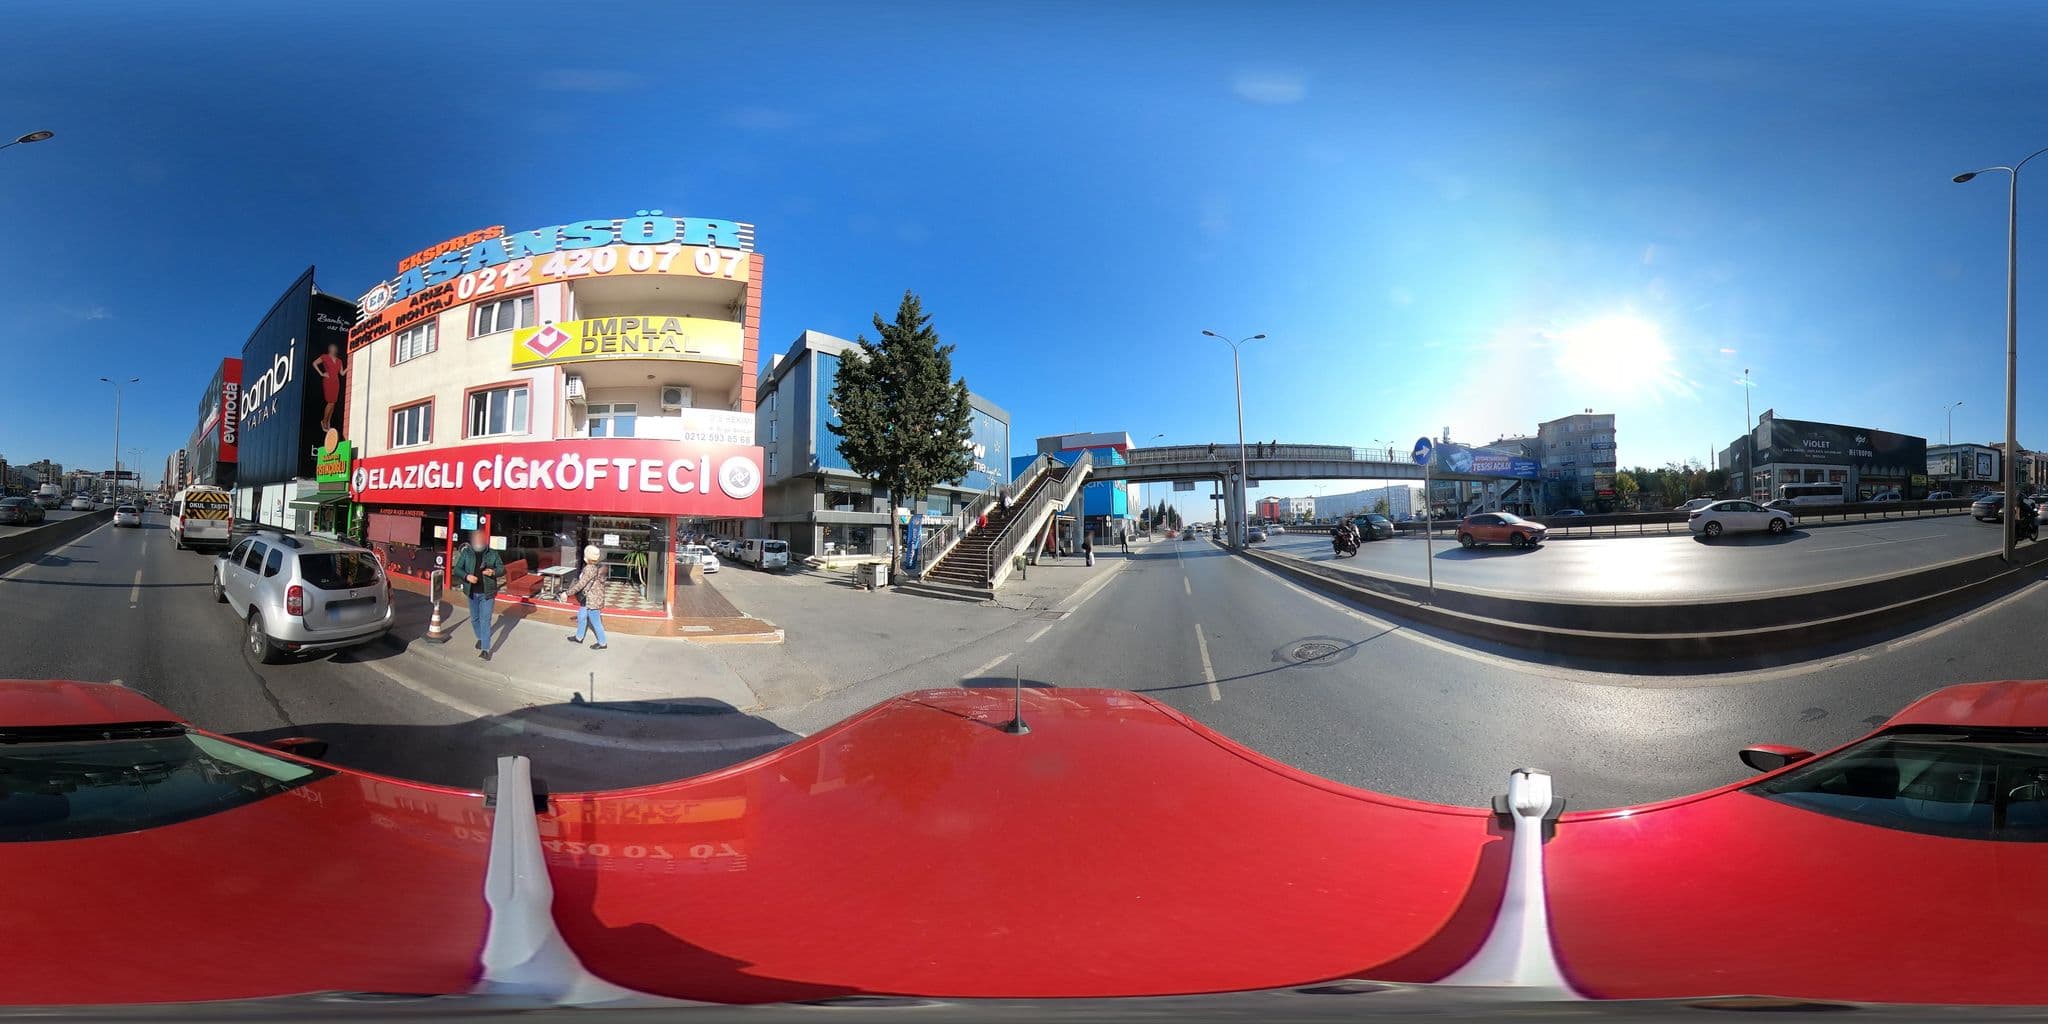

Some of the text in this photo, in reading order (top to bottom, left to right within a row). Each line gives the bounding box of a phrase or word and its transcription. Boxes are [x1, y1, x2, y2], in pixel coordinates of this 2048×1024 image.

[394, 209, 741, 300] ASANSÖR
[399, 225, 504, 274] EKSPRES
[457, 246, 744, 300] 0212 420 07 07
[396, 295, 454, 327] MONTAJ
[582, 317, 684, 337] IMPLA
[580, 333, 701, 354] DENTAL
[241, 338, 295, 421] bambi
[247, 398, 278, 432] YATAK
[368, 453, 711, 494] ELAZIĞLI ÇİĞKÖFTECİ
